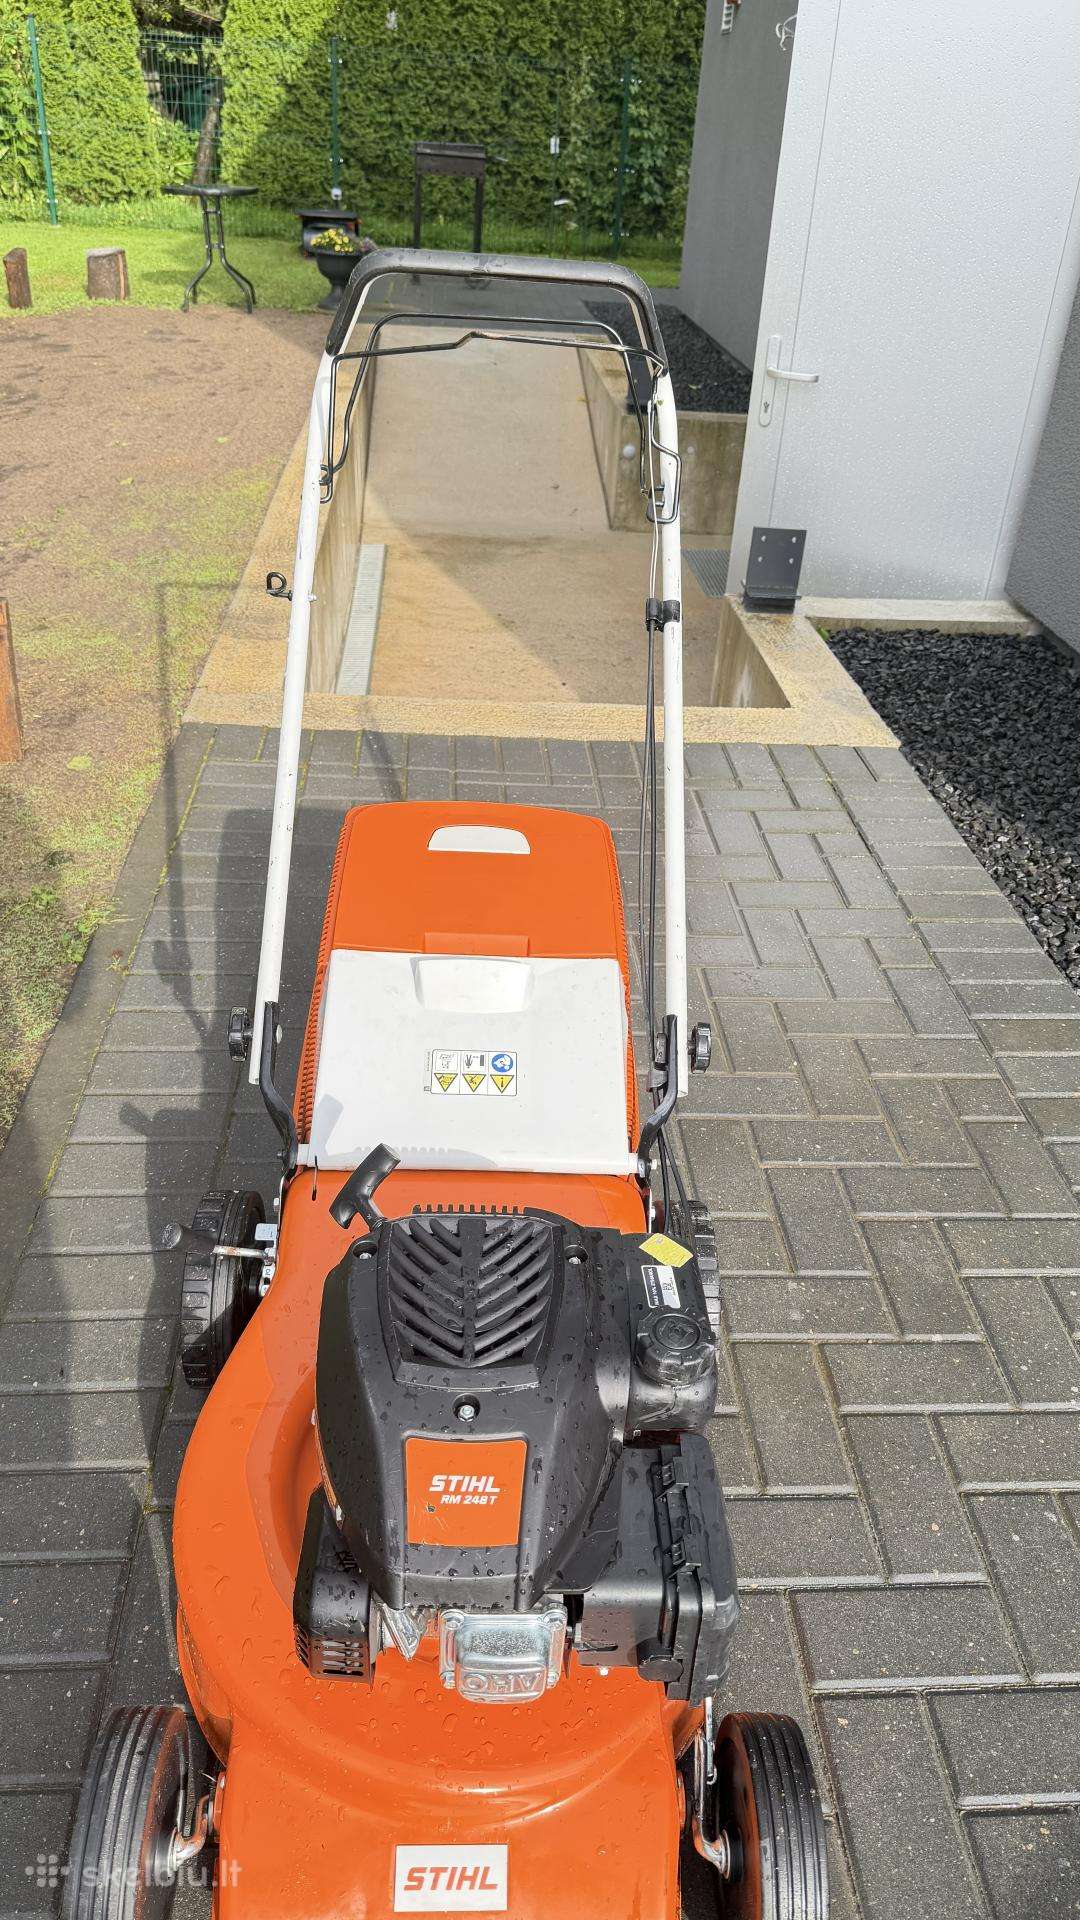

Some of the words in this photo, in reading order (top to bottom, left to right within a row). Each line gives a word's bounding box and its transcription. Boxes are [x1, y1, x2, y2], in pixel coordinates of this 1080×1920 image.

[429, 1474, 500, 1492] STIHL
[440, 1494, 461, 1505] RM
[462, 1672, 541, 1693] OHV
[403, 1866, 498, 1891] STIHL
